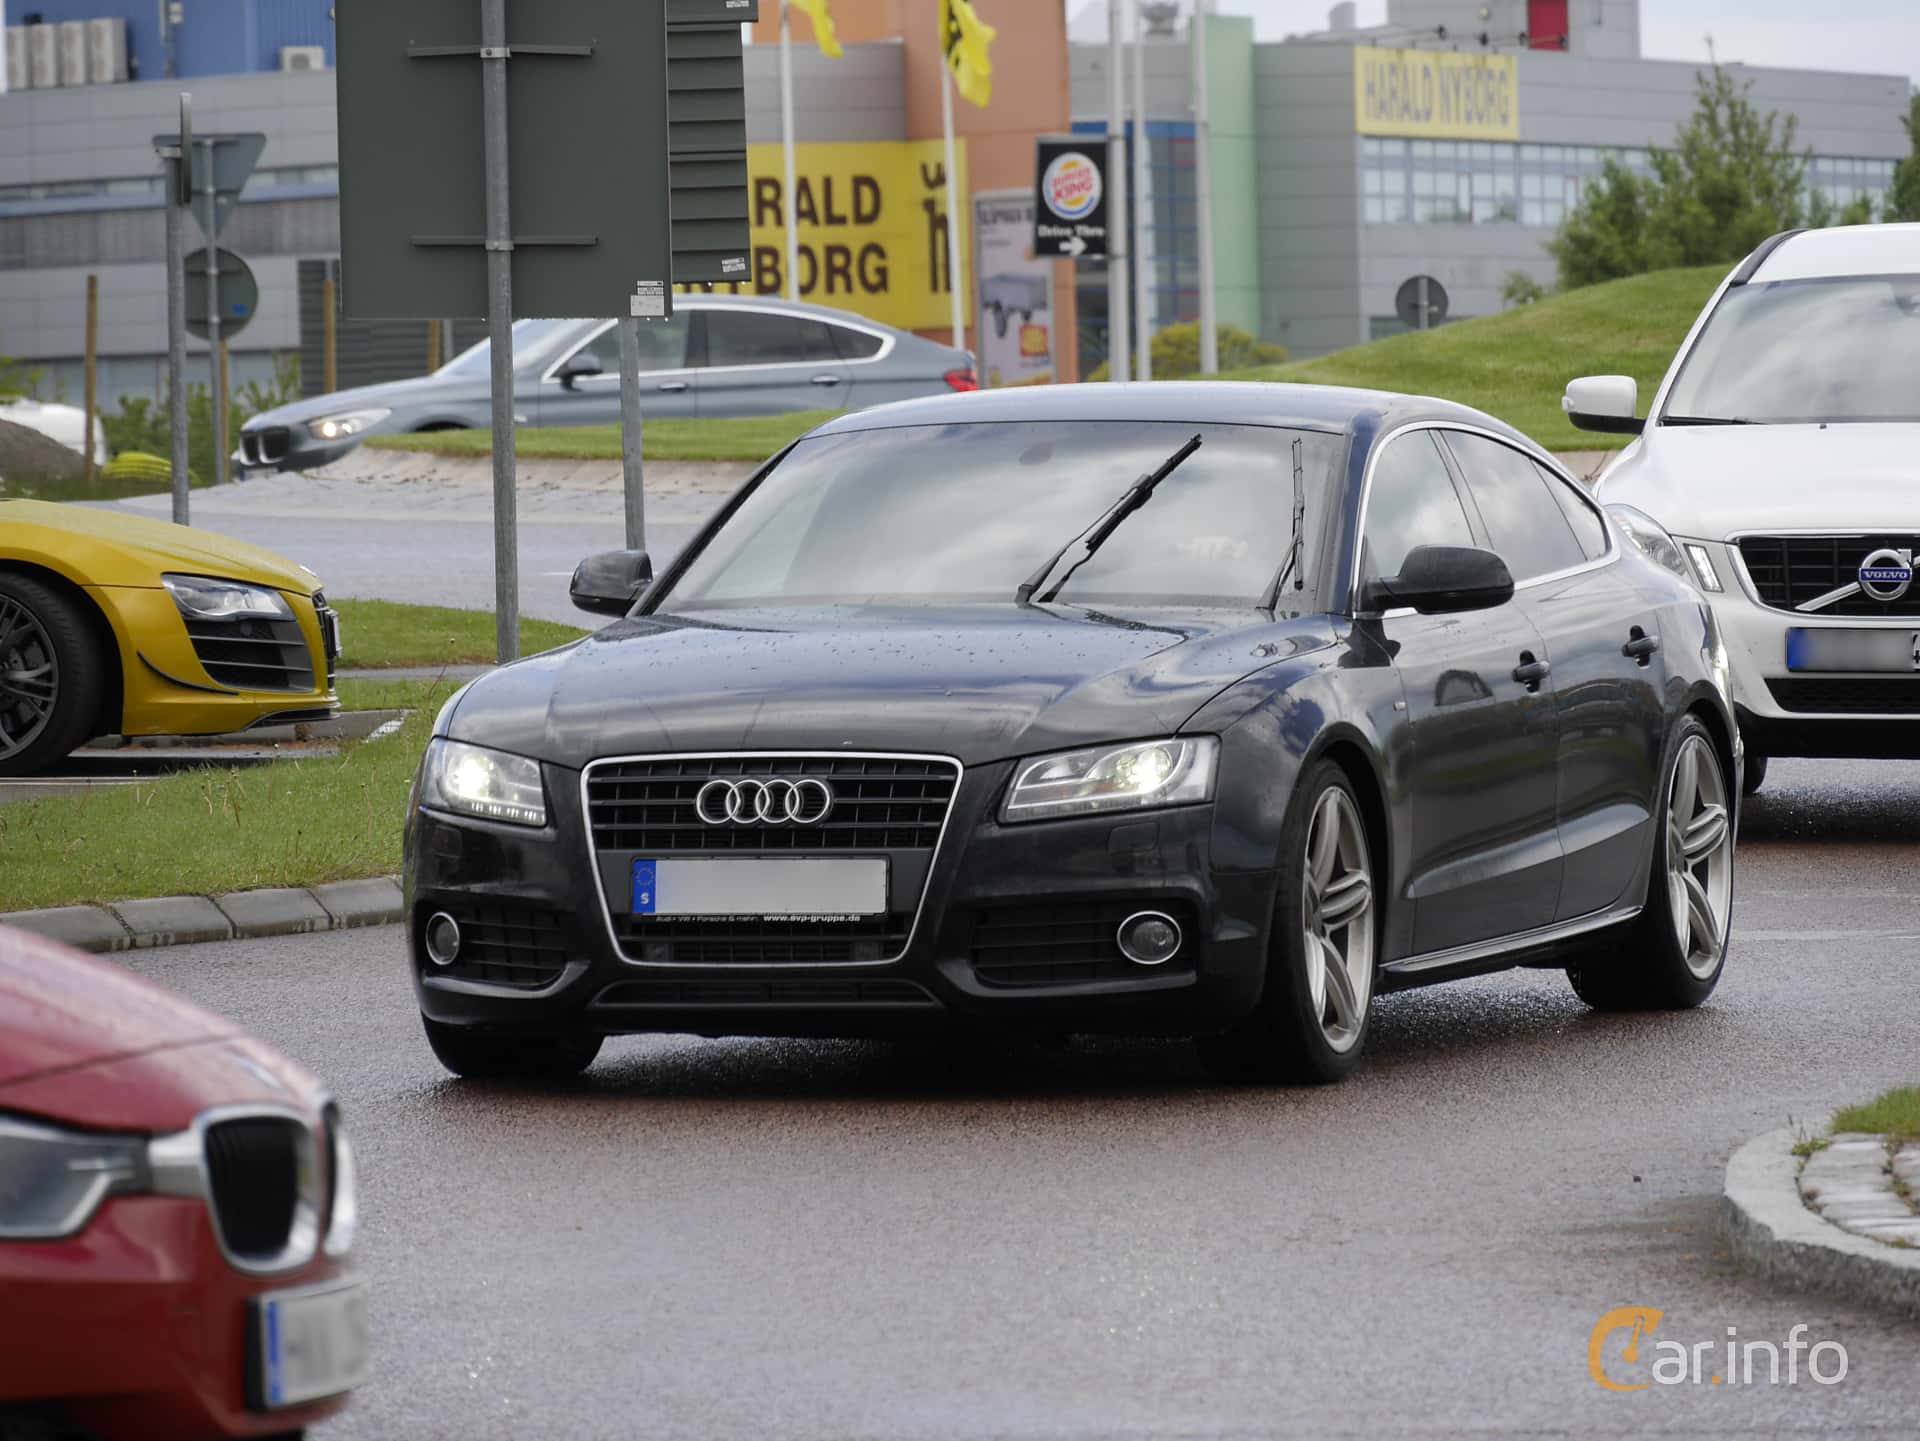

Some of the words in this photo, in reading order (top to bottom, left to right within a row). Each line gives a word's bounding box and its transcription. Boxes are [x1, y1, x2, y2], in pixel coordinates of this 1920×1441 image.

[1364, 63, 1432, 122] HARALD
[1439, 65, 1511, 127] NYBORG
[1053, 177, 1094, 200] KING
[1863, 570, 1908, 579] VOLVO
[640, 892, 650, 904] S
